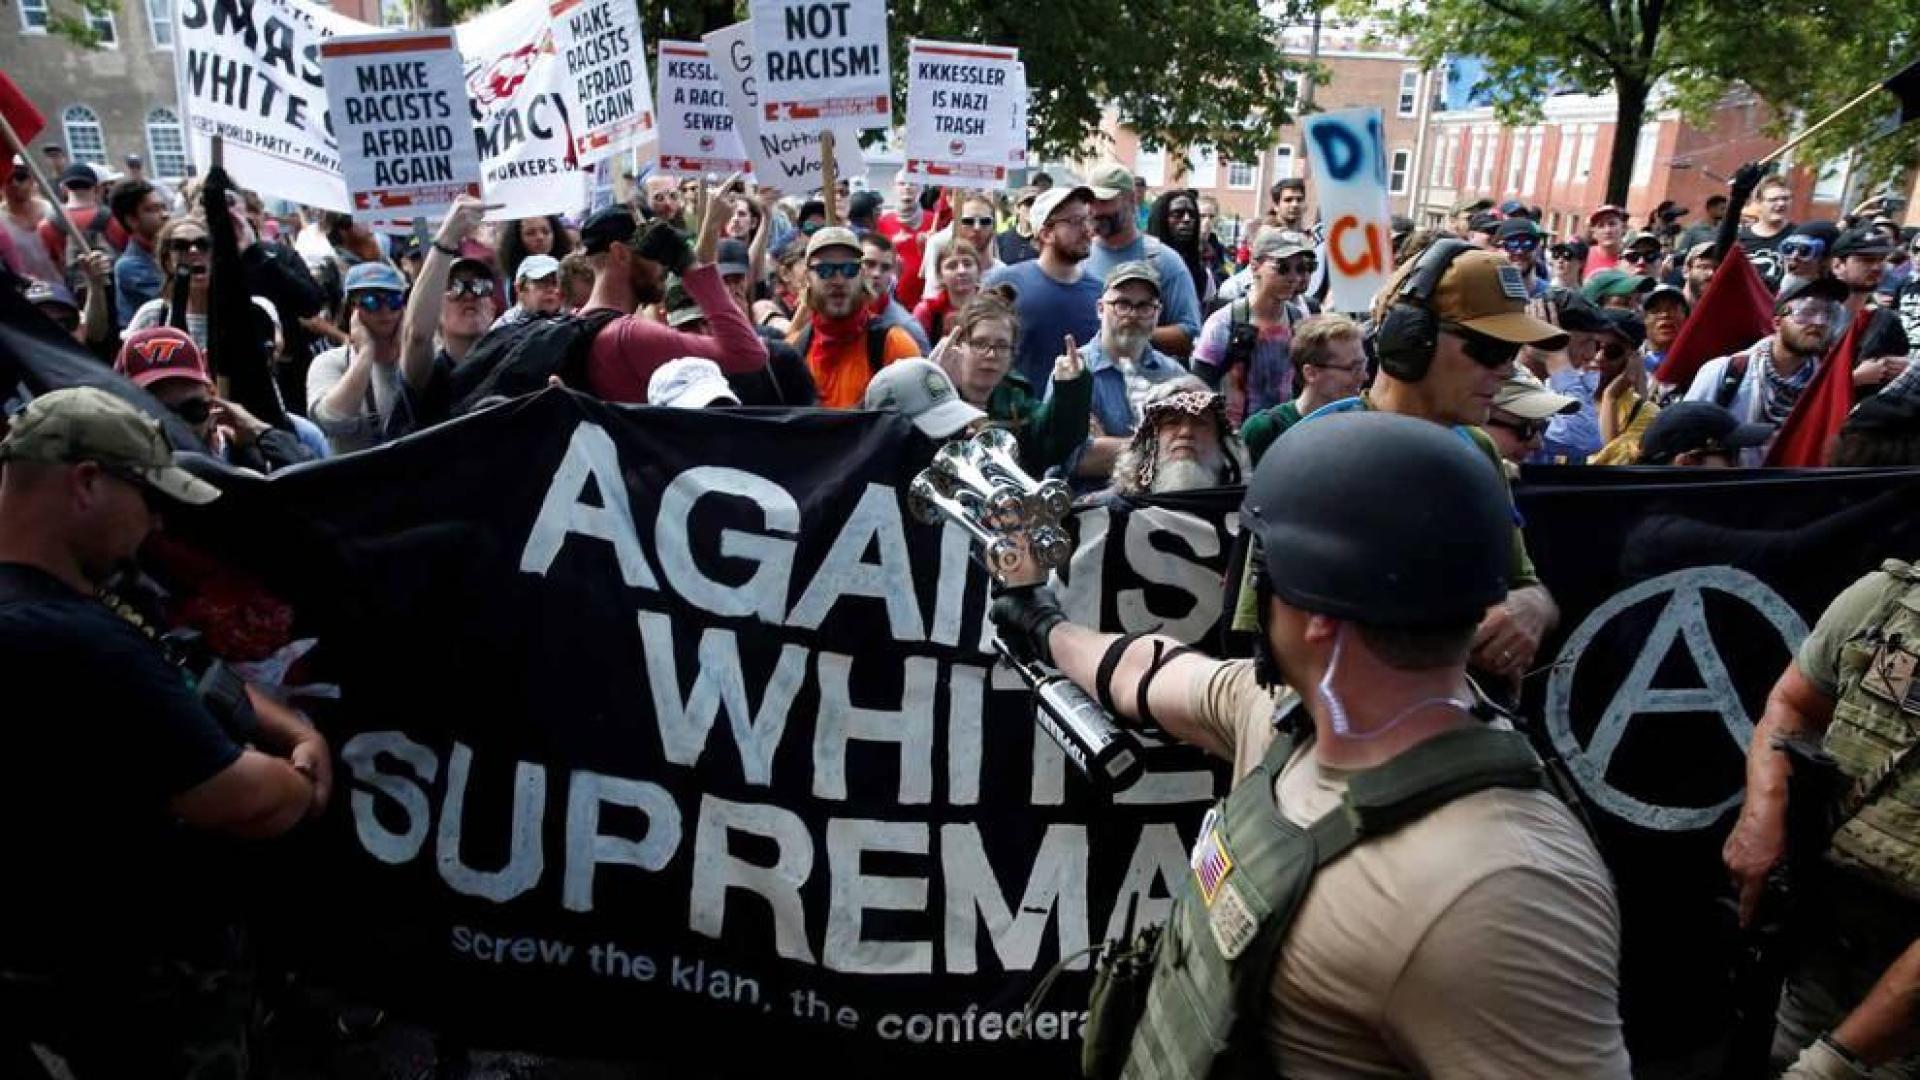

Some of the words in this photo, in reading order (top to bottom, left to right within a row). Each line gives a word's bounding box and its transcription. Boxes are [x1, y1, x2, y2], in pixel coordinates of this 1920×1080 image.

[570, 2, 613, 42] MAKE
[784, 3, 850, 41] NOT
[566, 27, 629, 75] RACISTS
[766, 45, 880, 82] RACISM!
[356, 62, 428, 93] MAKE
[578, 60, 632, 103] AFRAID
[918, 62, 1006, 86] KKKESSLER
[345, 91, 451, 124] RACISTS
[586, 89, 634, 128] AGAIN
[675, 87, 685, 104] A
[690, 88, 729, 107] RACI
[932, 90, 947, 107] IS
[951, 92, 988, 111] NAZI
[684, 112, 733, 132] SEWER
[935, 115, 985, 134] TRASH
[363, 125, 453, 157] AFRAID
[375, 155, 453, 186] AGAIN
[452, 925, 574, 964] screw
[588, 943, 656, 980] the
[672, 956, 772, 1013] klan,
[790, 990, 859, 1029] the
